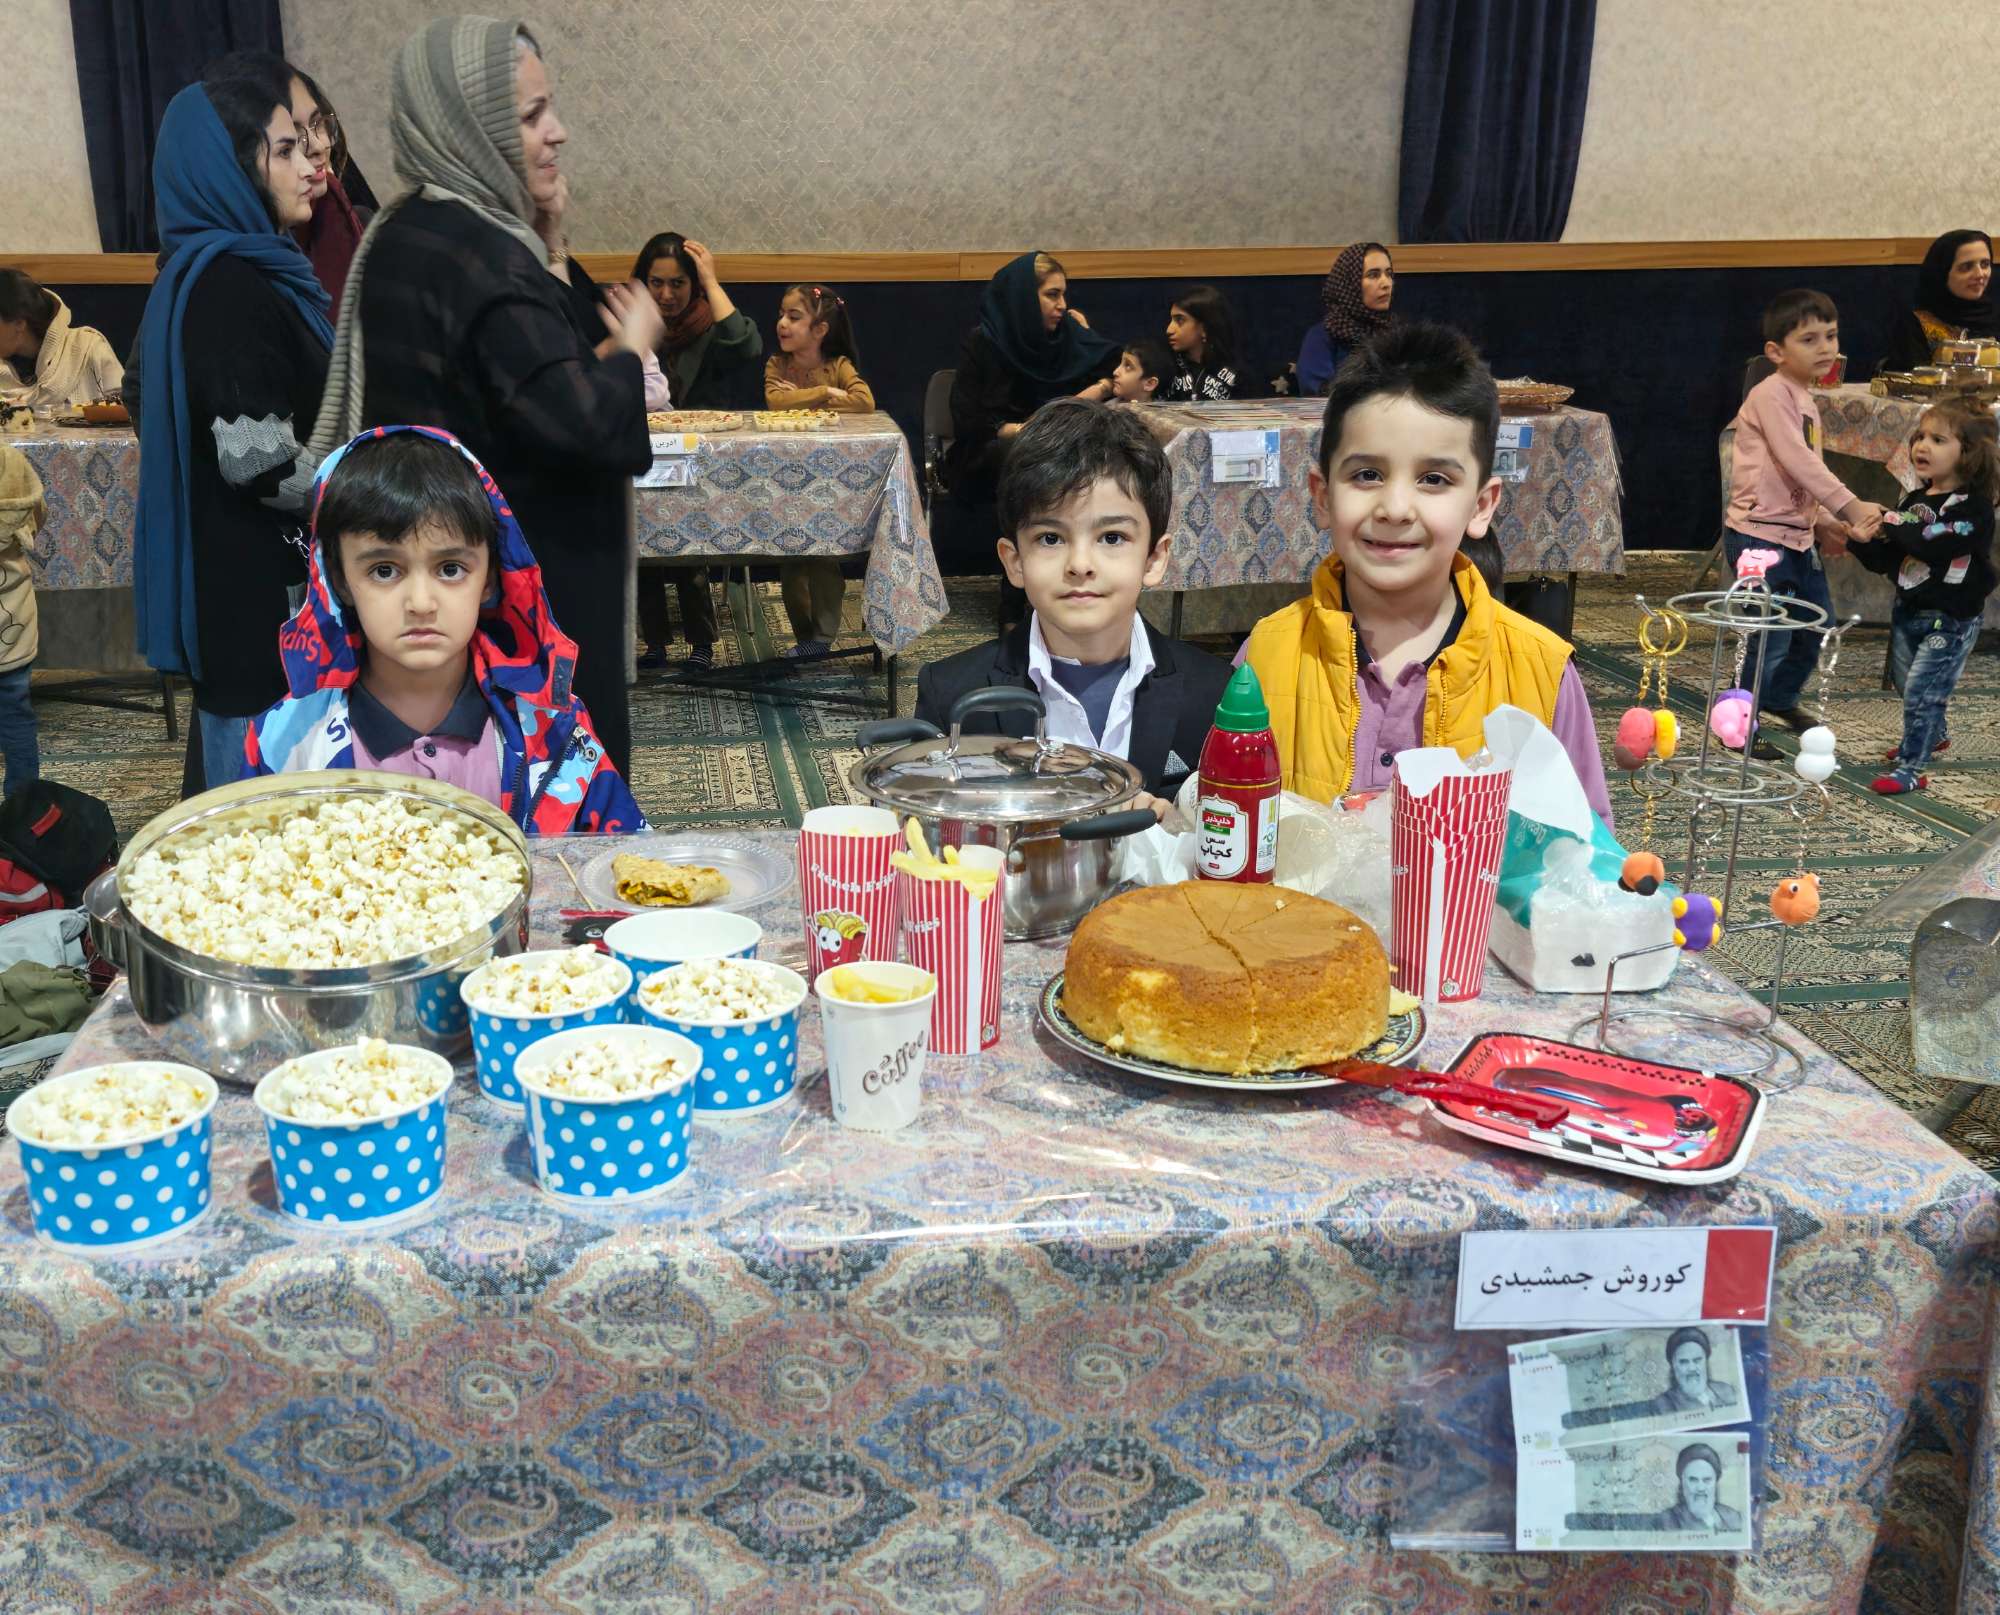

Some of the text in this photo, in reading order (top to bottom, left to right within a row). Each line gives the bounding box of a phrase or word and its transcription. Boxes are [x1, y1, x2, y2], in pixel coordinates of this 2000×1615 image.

[1206, 836, 1226, 845] سس
[1200, 845, 1232, 860] کچاپ
[862, 1030, 925, 1096] Coffee
[1480, 1263, 1692, 1295] کوروش جمشیدی
